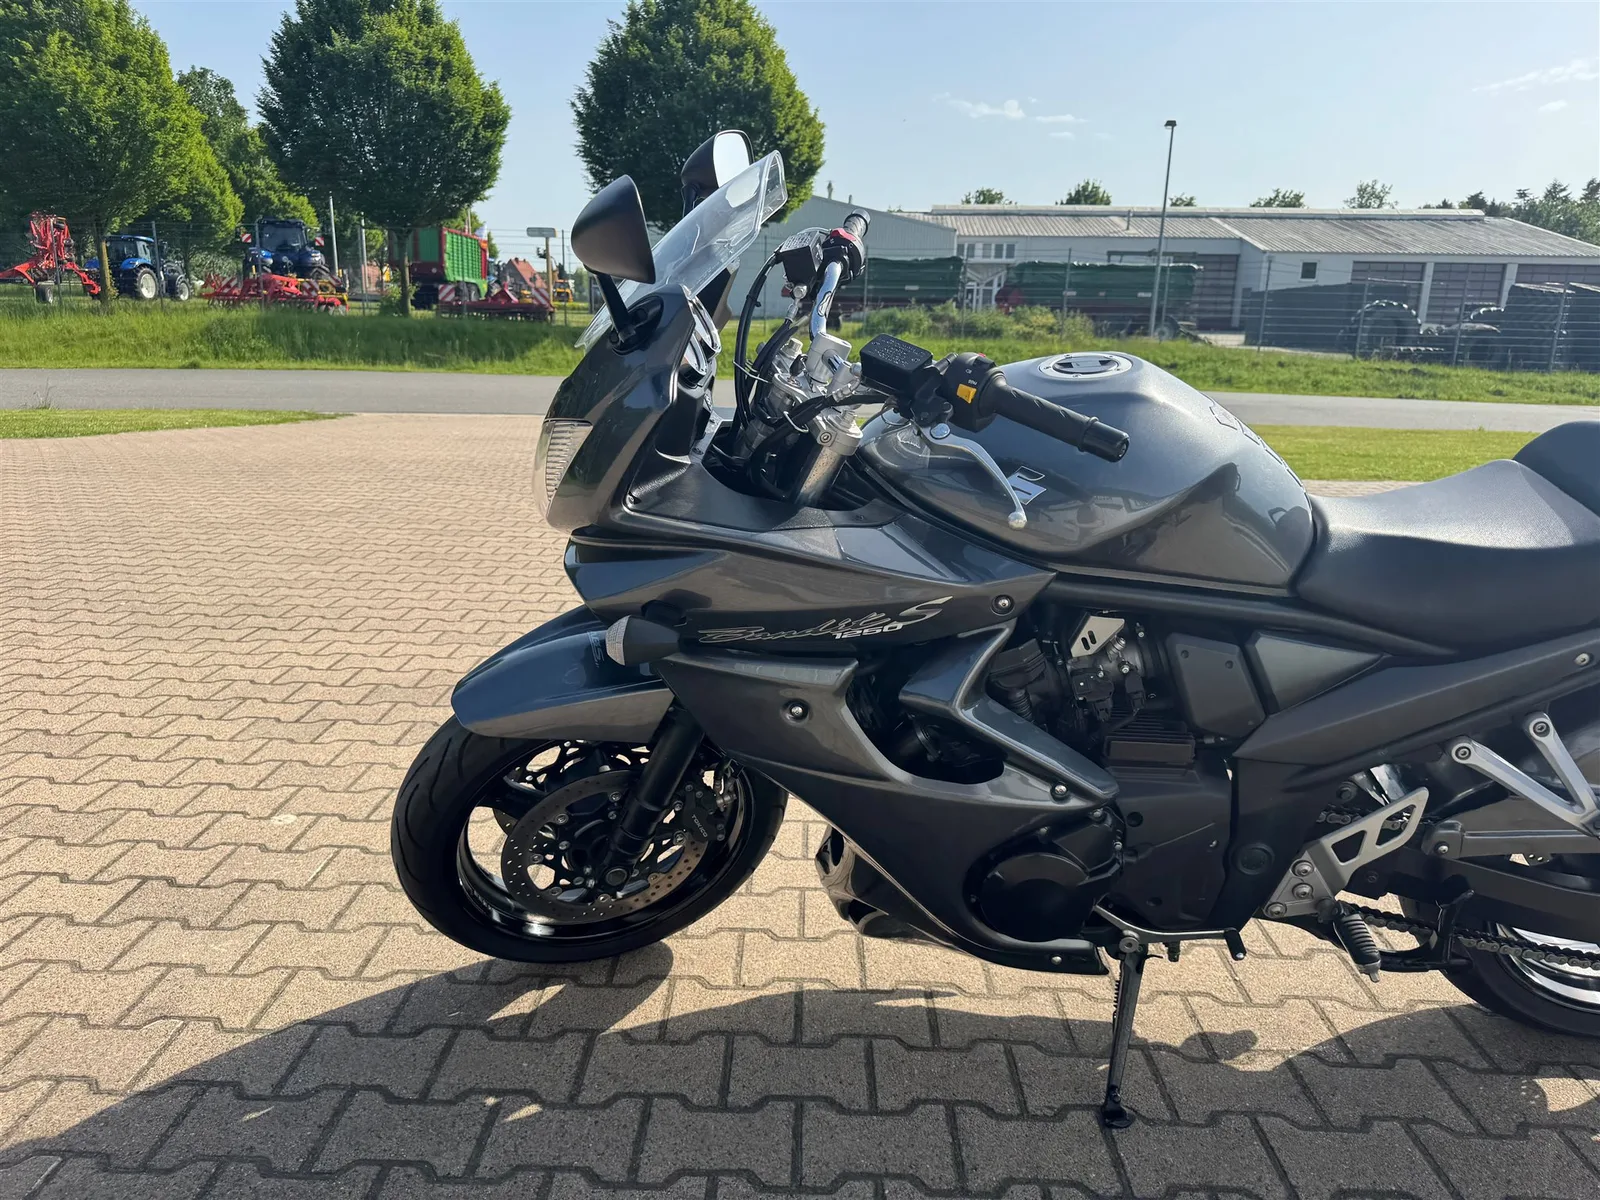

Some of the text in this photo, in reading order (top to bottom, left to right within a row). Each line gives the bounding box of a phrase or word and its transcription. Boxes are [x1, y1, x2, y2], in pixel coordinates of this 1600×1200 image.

[697, 595, 954, 644] Bandit S
[831, 622, 904, 640] 1250
[691, 814, 708, 838] TOKICO
